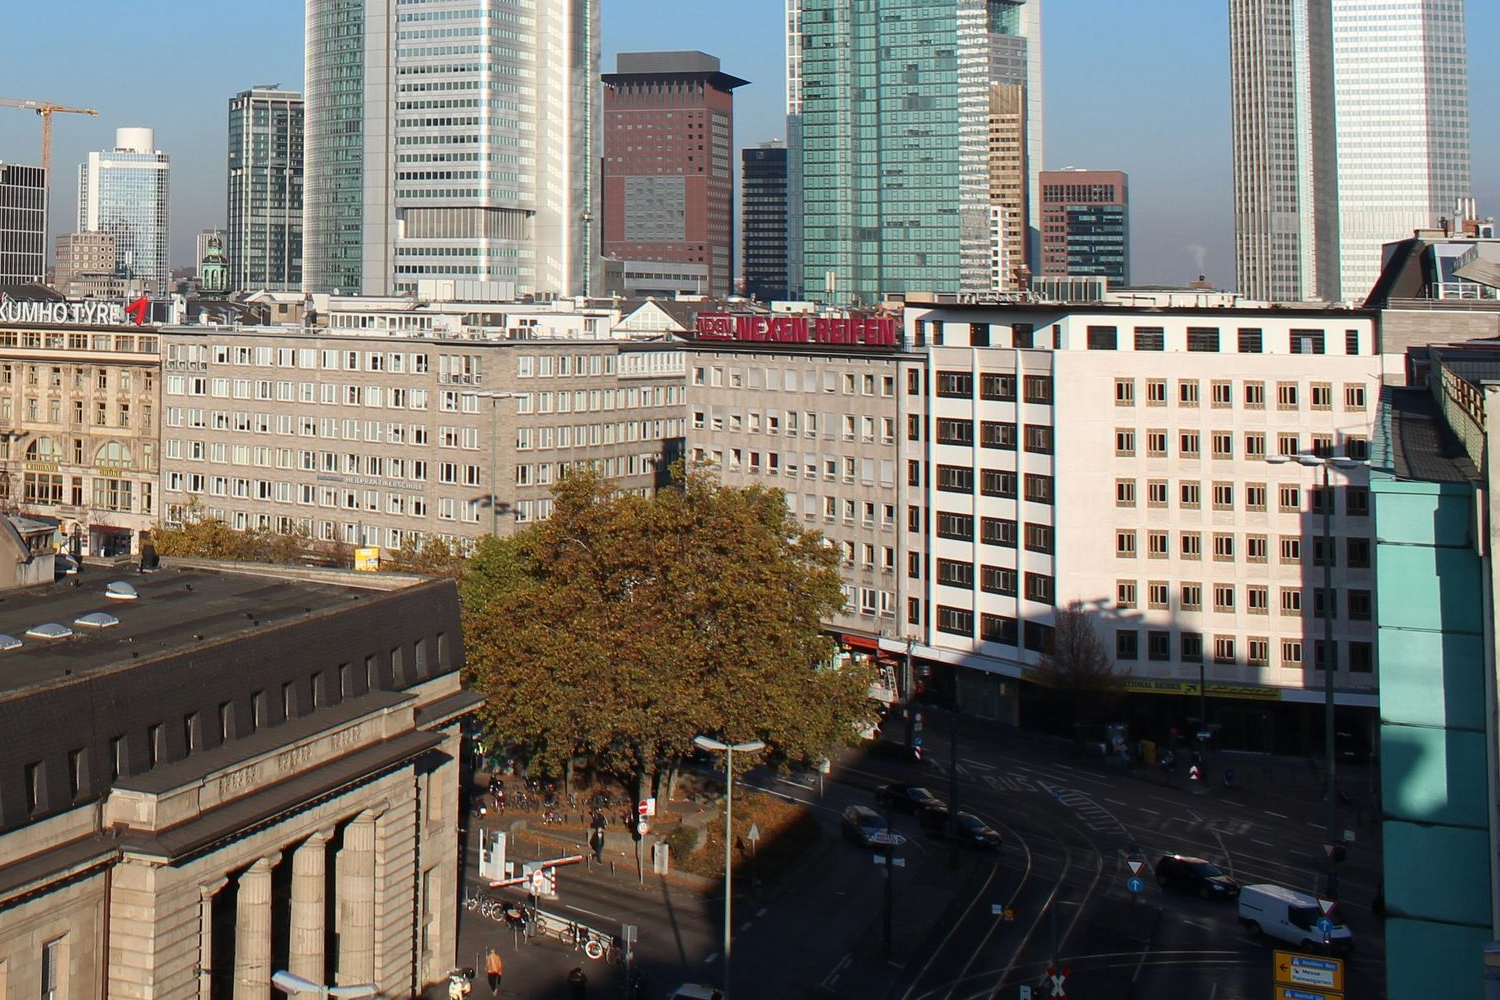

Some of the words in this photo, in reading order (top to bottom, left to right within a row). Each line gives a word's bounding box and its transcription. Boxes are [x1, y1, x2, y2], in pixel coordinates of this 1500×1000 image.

[71, 301, 121, 325] TYRE
[737, 317, 809, 342] NEXEN
[814, 318, 895, 345] REIFEN
